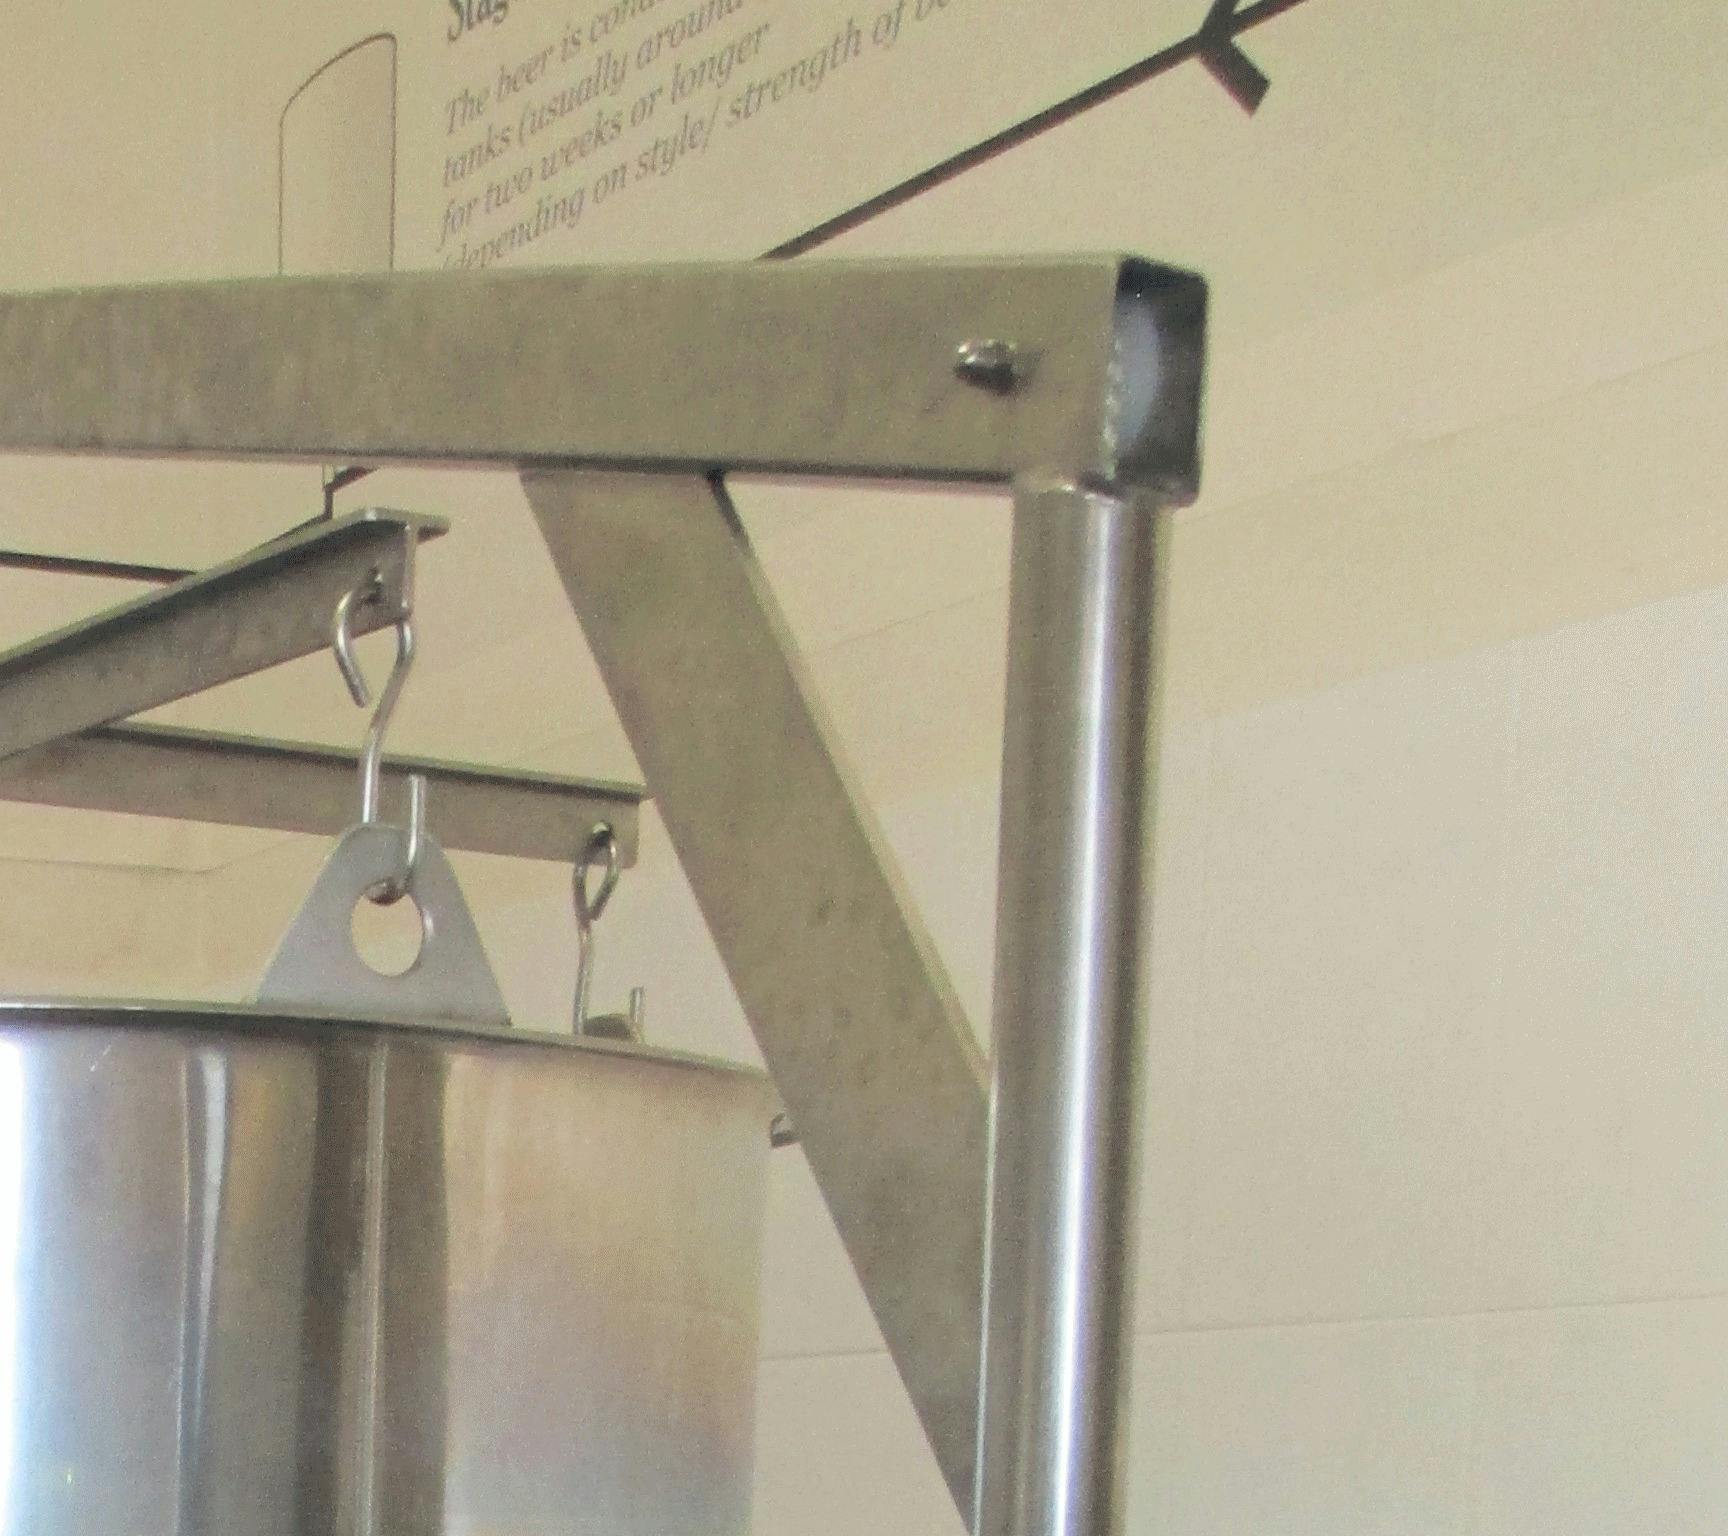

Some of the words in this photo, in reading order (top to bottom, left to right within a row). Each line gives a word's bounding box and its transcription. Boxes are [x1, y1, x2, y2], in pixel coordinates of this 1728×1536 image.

[435, 197, 479, 252] for
[485, 165, 534, 214] two
[540, 109, 624, 181] weeks
[630, 85, 663, 127] or
[671, 22, 770, 105] longer
[443, 121, 513, 188] tanks
[518, 50, 628, 147] (usually
[446, 88, 490, 136] The
[497, 47, 554, 101] beer
[560, 23, 582, 62] is
[593, 162, 627, 204] on
[635, 96, 722, 181] style/
[726, 17, 862, 129] strength
[873, 0, 905, 50] of
